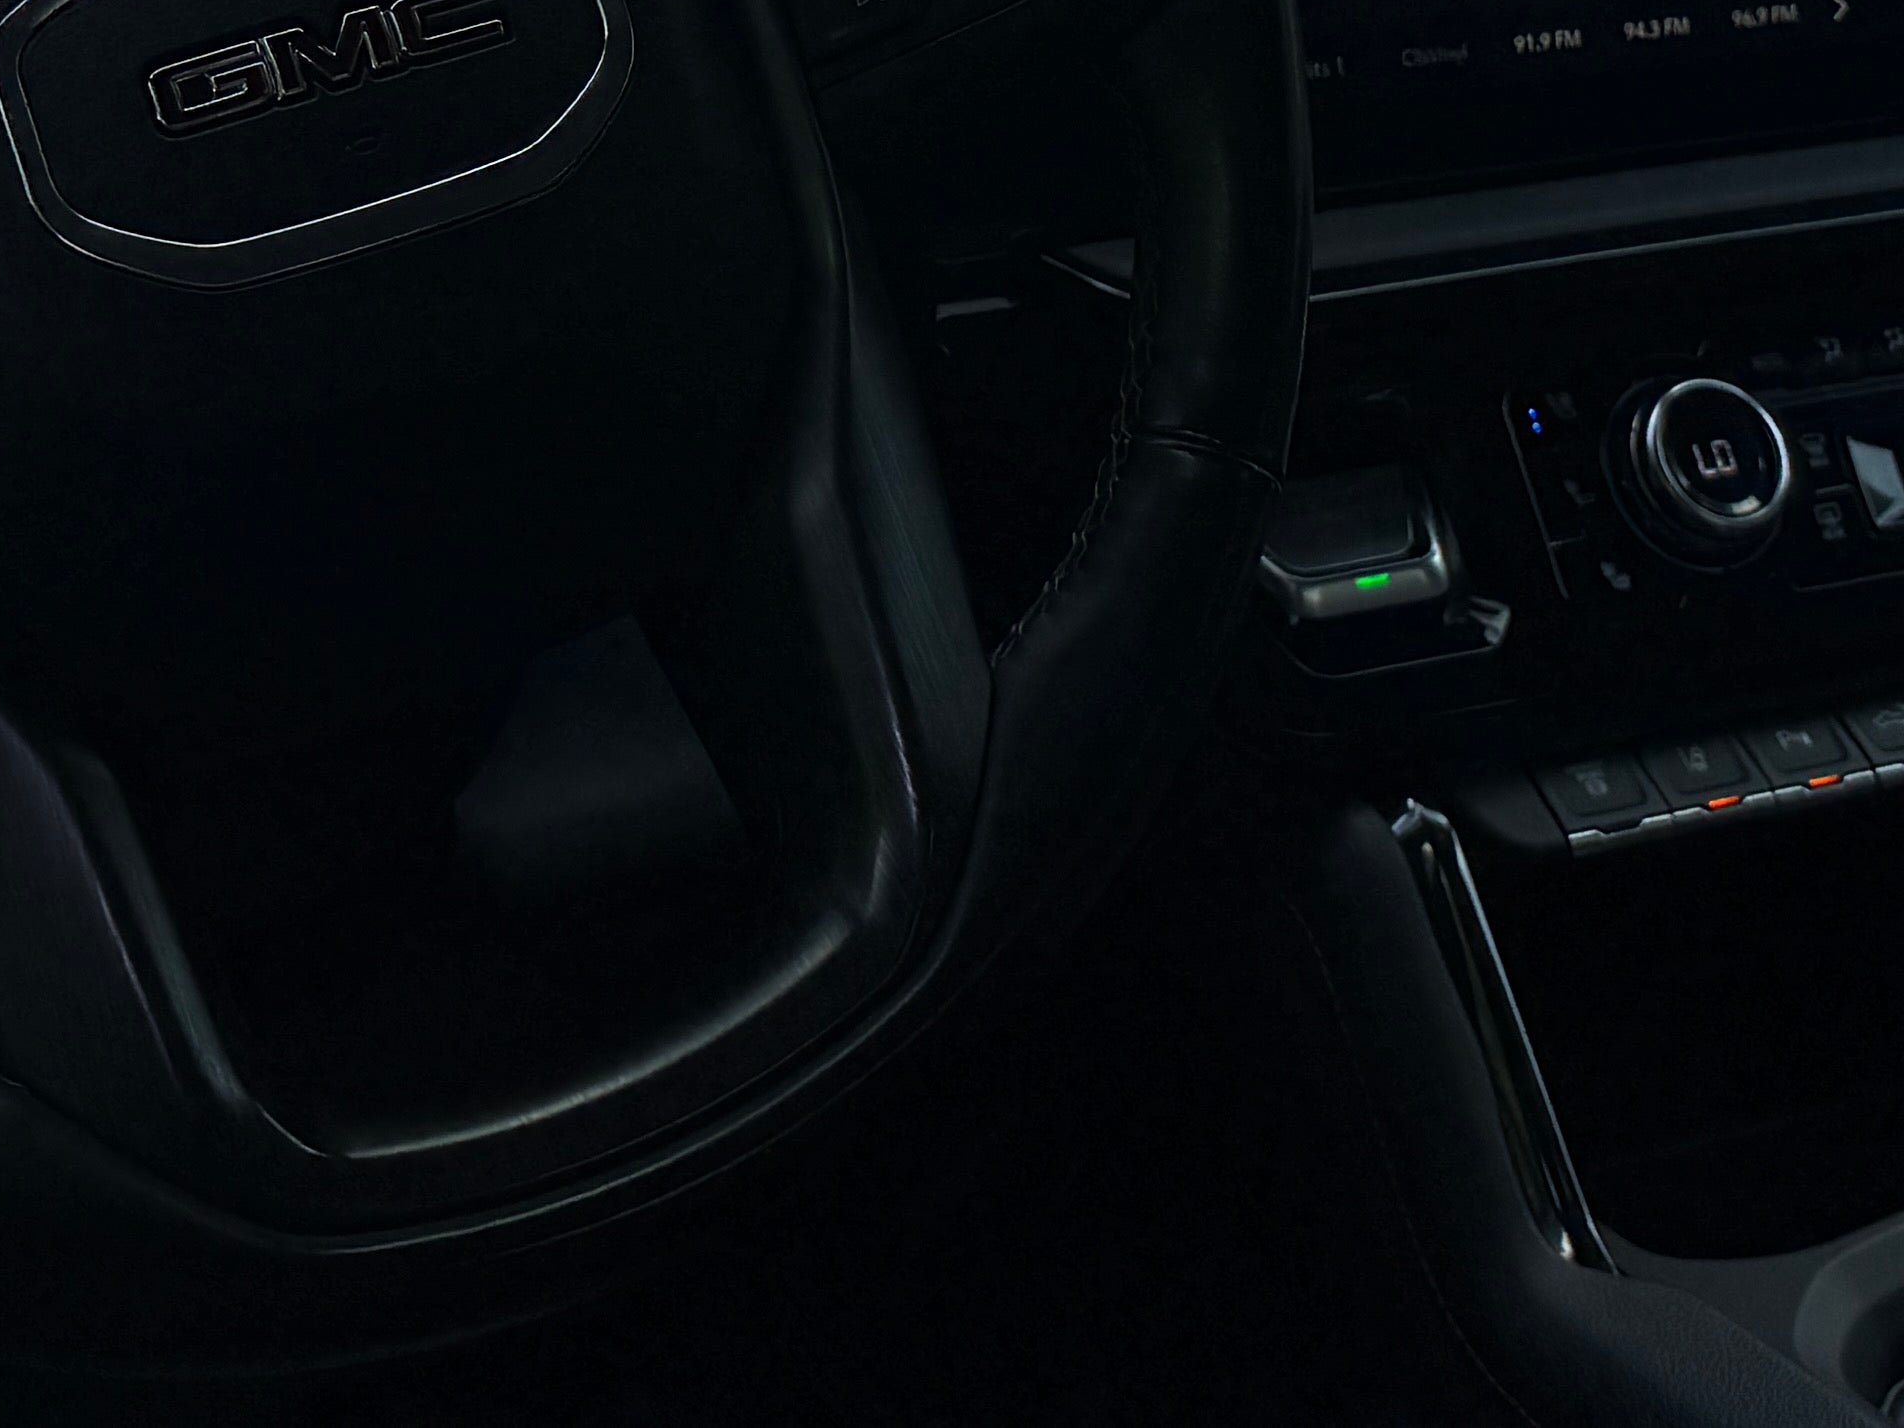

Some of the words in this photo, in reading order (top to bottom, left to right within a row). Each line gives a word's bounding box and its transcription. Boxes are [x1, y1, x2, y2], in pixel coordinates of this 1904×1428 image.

[1770, 3, 1798, 24] FM
[1663, 15, 1692, 38] FM
[1512, 31, 1553, 55] 91.9
[1555, 28, 1583, 50] FM
